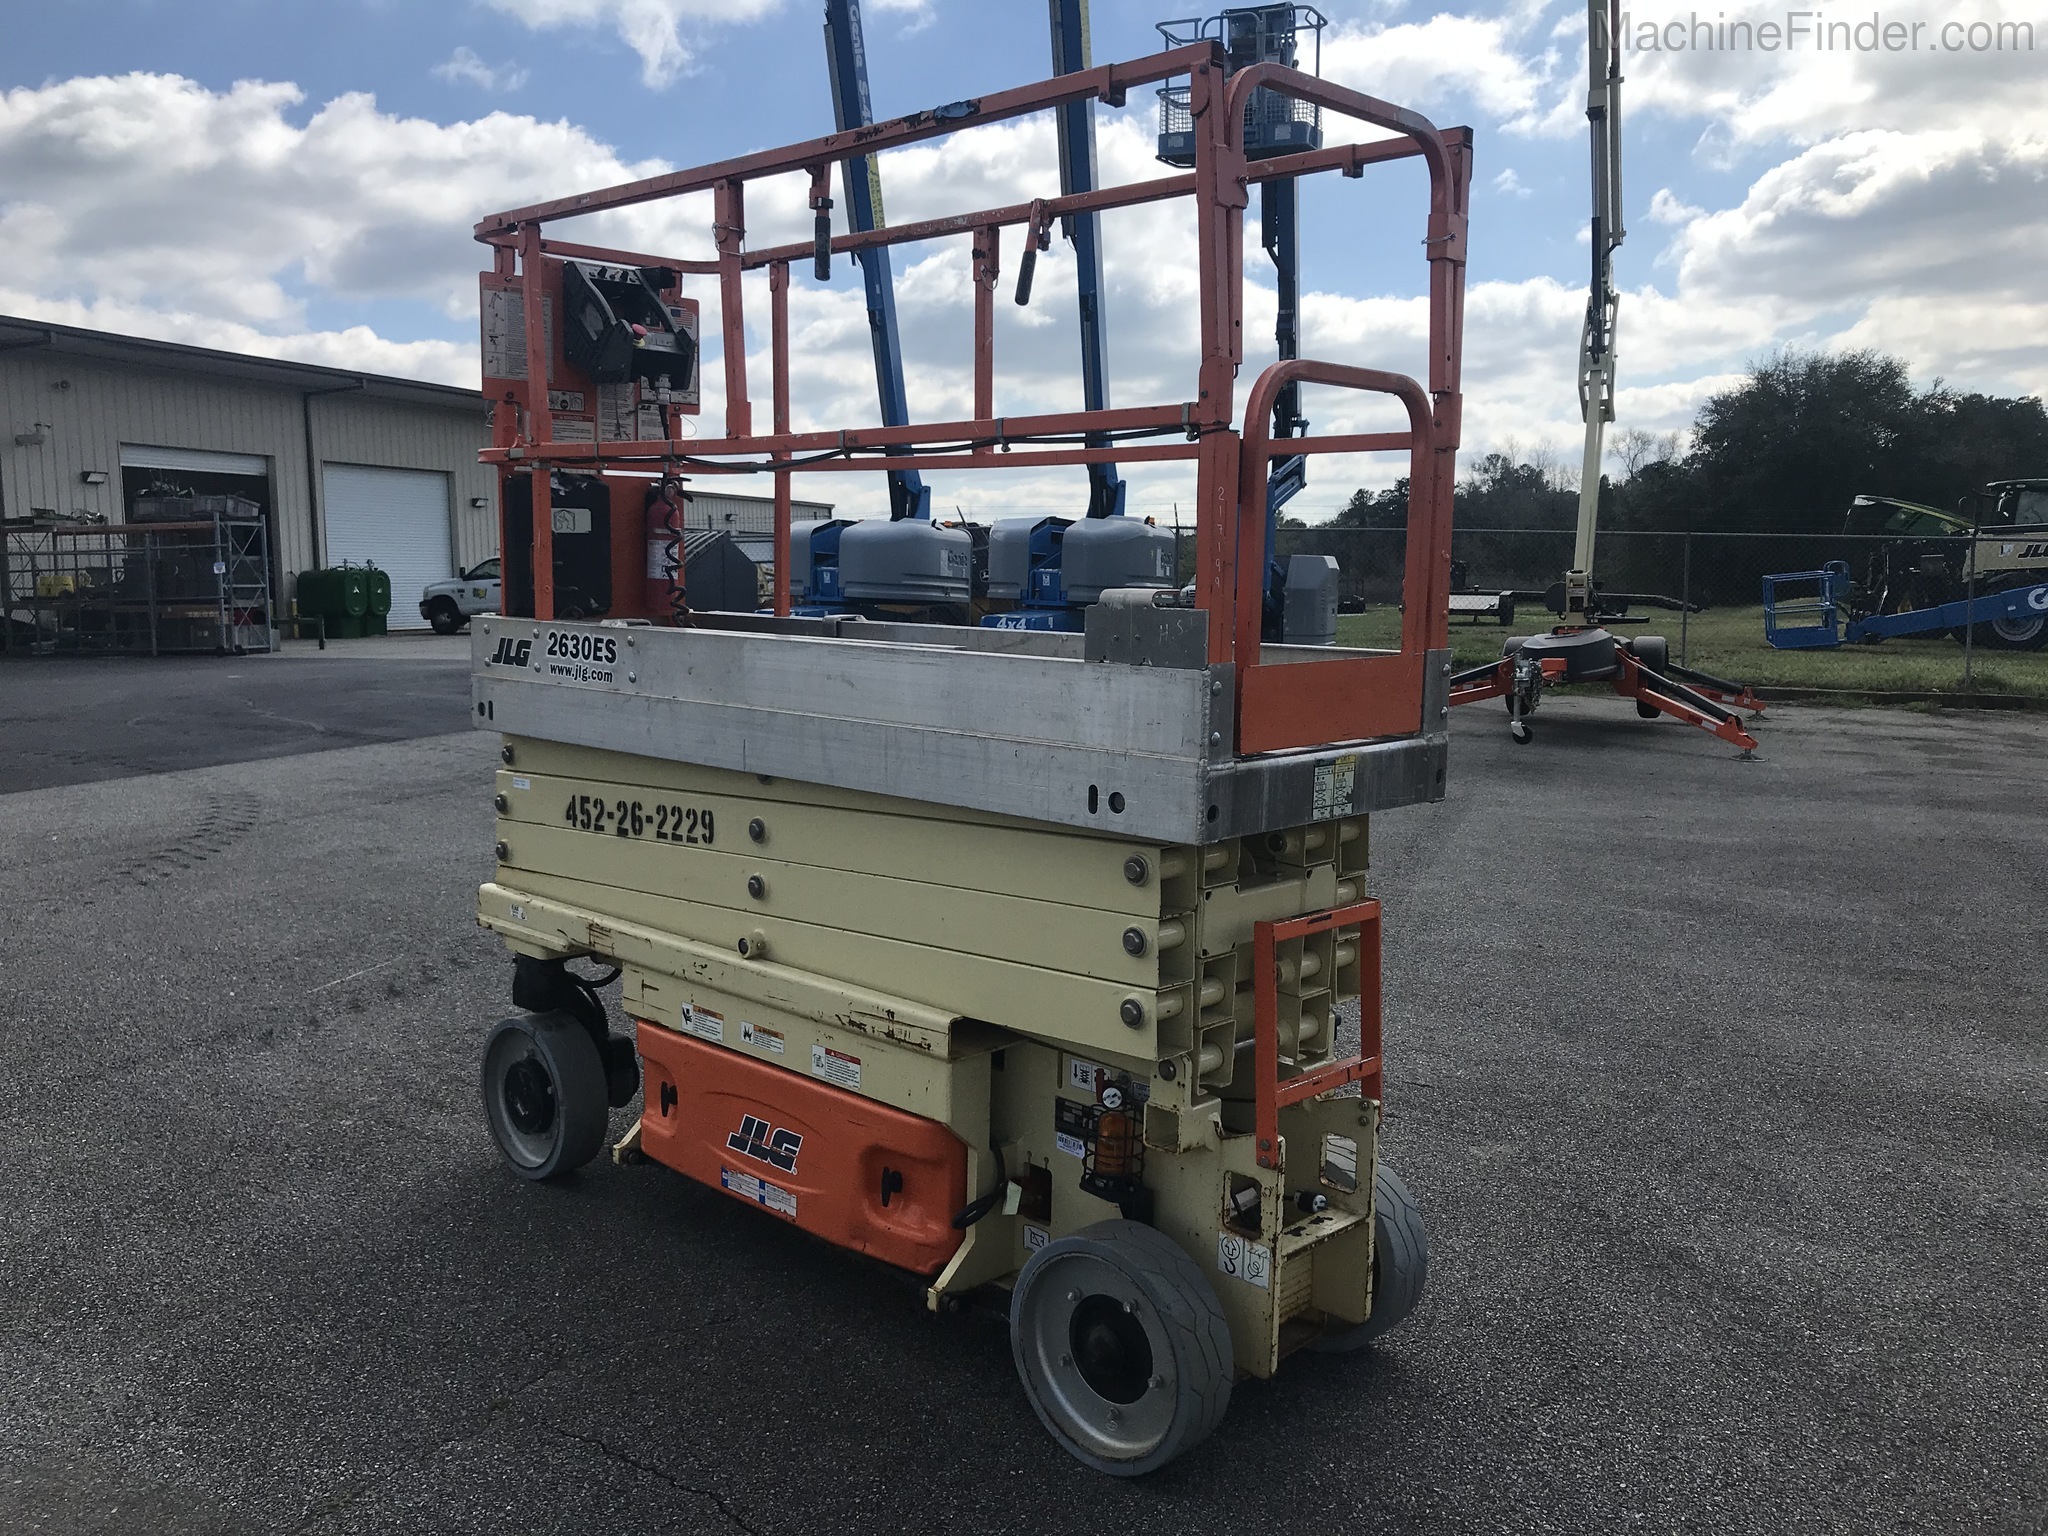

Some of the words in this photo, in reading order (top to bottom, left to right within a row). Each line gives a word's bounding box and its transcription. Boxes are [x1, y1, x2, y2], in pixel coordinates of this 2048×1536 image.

[996, 616, 1027, 630] 4x4
[491, 637, 533, 668] JLG
[546, 631, 617, 664] 2630ES
[549, 663, 613, 683] www.jlg.com
[565, 794, 715, 845] 452-26-2229
[725, 1113, 804, 1174] JLG
